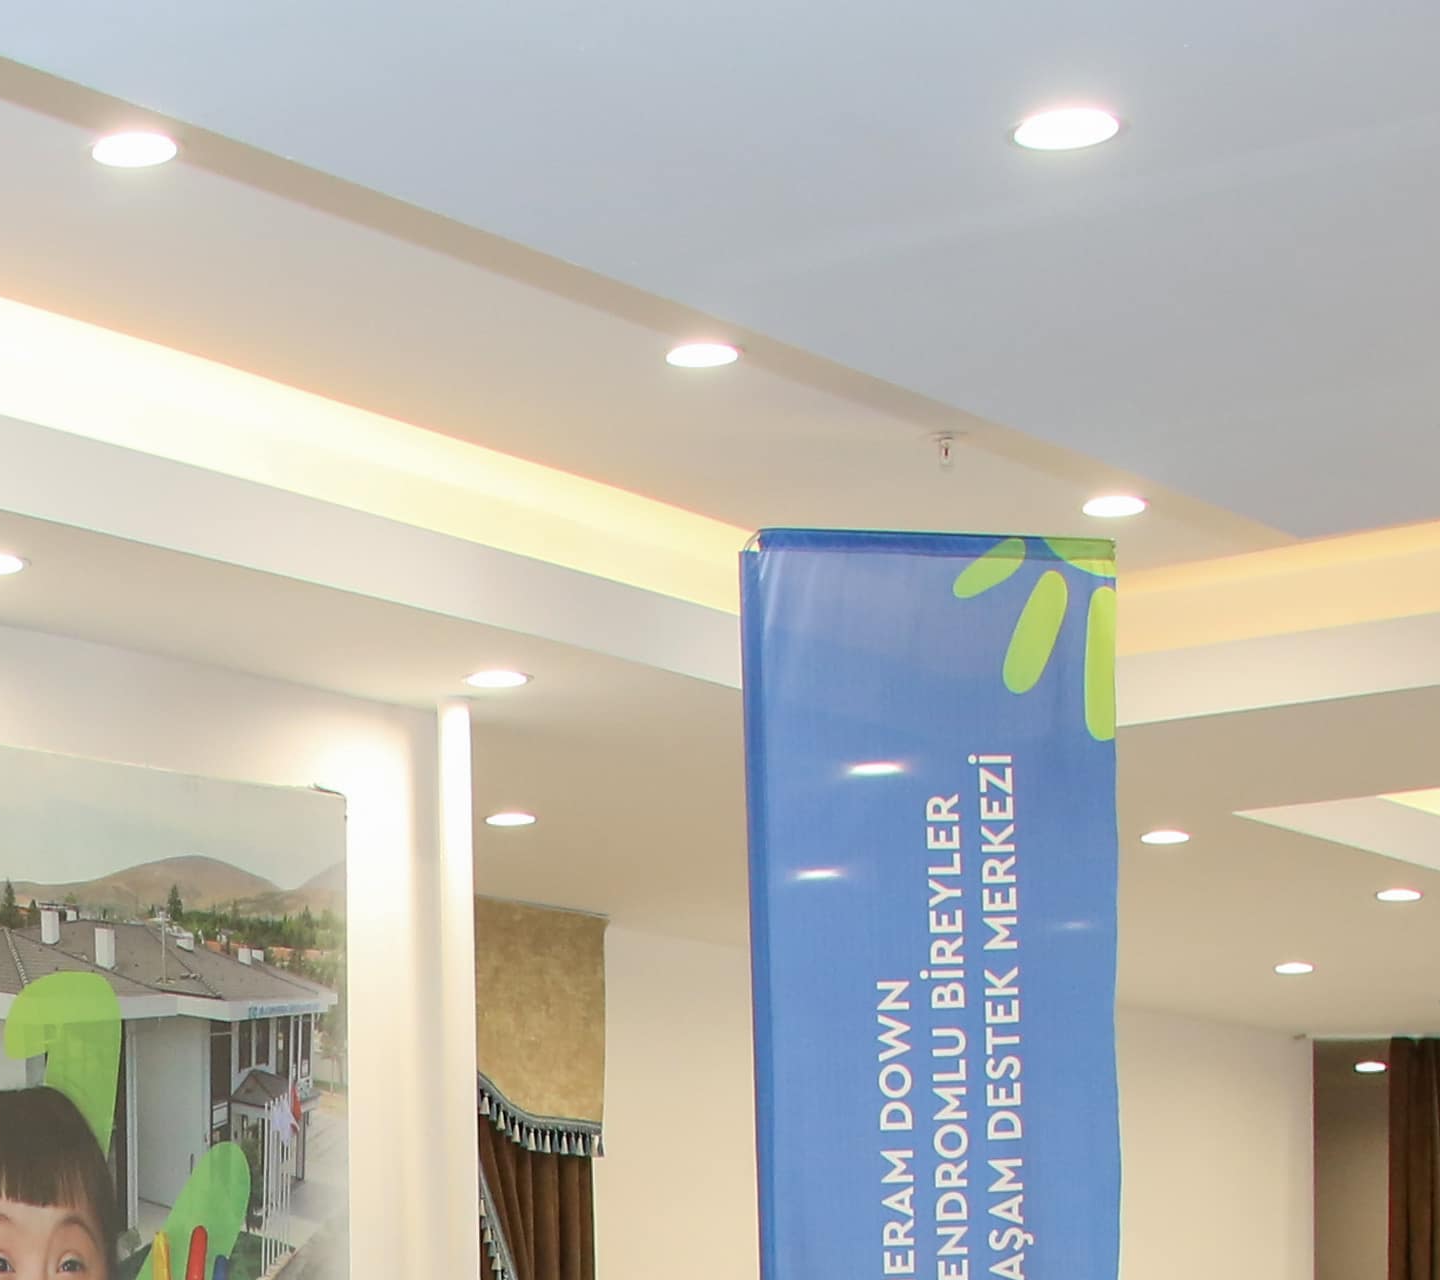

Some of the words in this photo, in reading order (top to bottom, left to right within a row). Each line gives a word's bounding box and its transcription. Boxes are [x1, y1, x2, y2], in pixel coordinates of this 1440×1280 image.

[920, 793, 966, 1009] BİREYLER
[968, 755, 1019, 951] MERKEZİ
[876, 981, 913, 1131] DOWN
[983, 967, 1023, 1141] DESTEK
